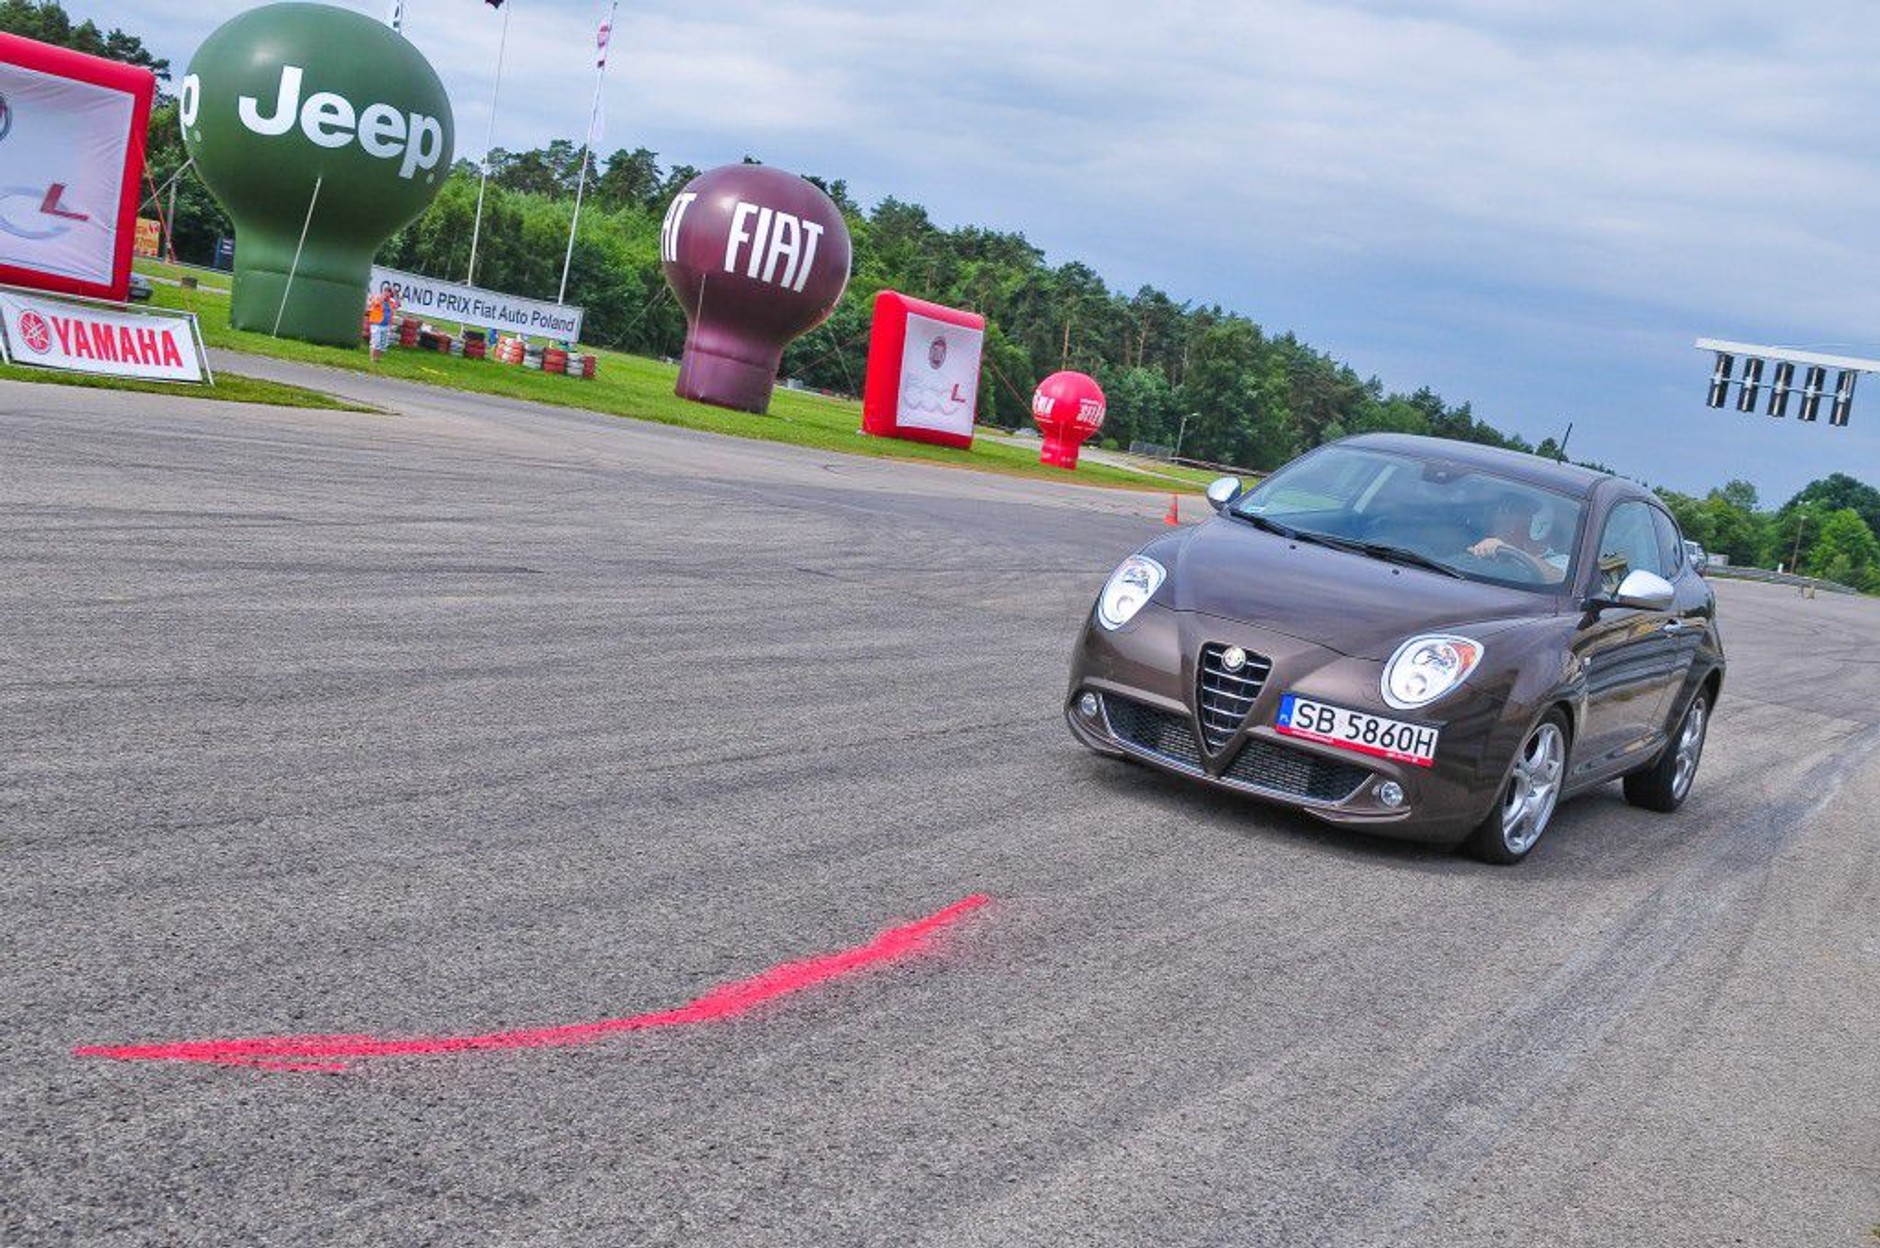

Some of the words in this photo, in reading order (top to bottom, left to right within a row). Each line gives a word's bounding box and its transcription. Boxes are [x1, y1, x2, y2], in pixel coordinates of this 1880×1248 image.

[238, 65, 442, 179] Jeep
[724, 202, 824, 293] FIAT
[437, 292, 472, 315] PRIX
[473, 301, 498, 319] Fiat
[498, 306, 528, 325] Auto
[531, 310, 575, 332] Poland
[51, 315, 184, 369] YAMAHA
[1296, 703, 1336, 733] SB
[1345, 715, 1434, 757] 5860H
